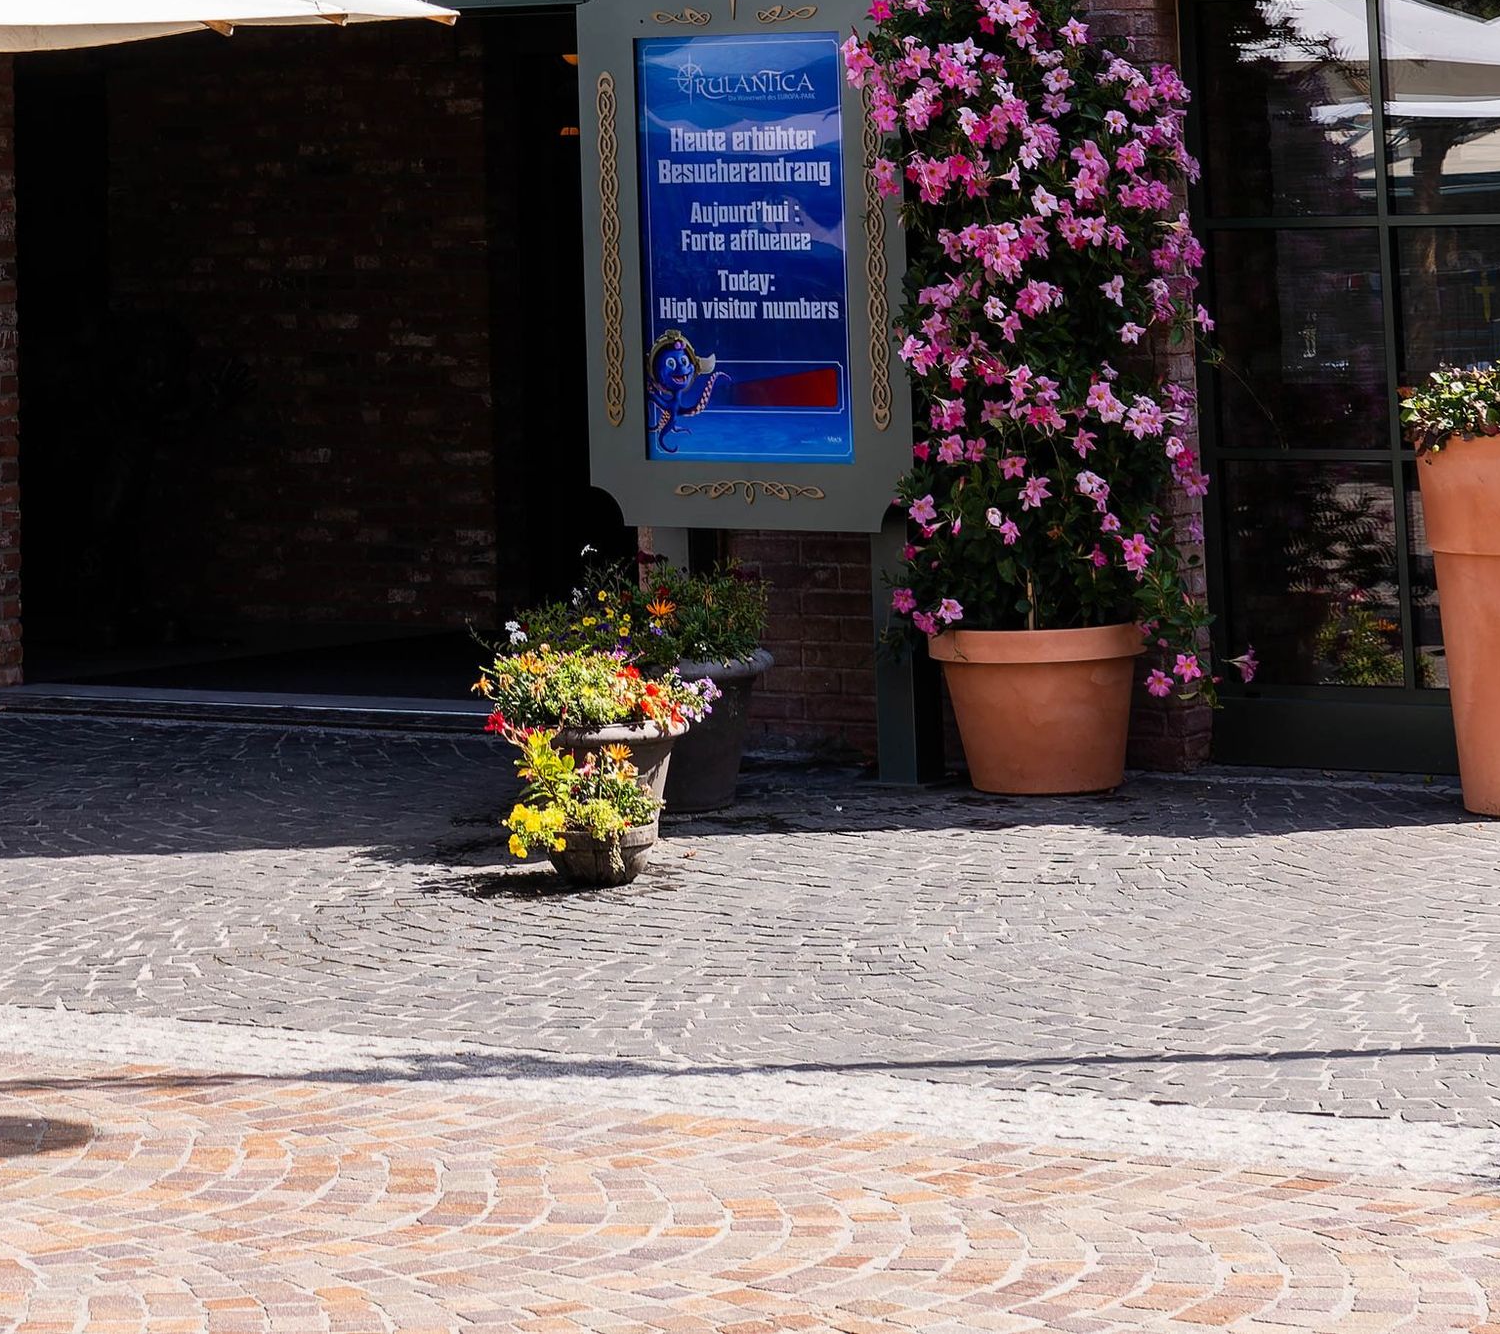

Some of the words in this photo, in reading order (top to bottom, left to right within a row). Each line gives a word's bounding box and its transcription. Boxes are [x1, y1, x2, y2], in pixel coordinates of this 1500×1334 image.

[694, 69, 815, 100] RULANTICA
[670, 128, 726, 152] Heute
[731, 125, 816, 151] erhöhter
[657, 157, 831, 186] Besucherandrang
[690, 200, 789, 227] Aujourd'hui
[681, 229, 726, 252] Forte
[730, 229, 812, 251] affluence
[717, 269, 776, 296] Today:
[659, 297, 698, 323] High
[702, 297, 758, 320] visitor
[762, 297, 840, 320] numbers
